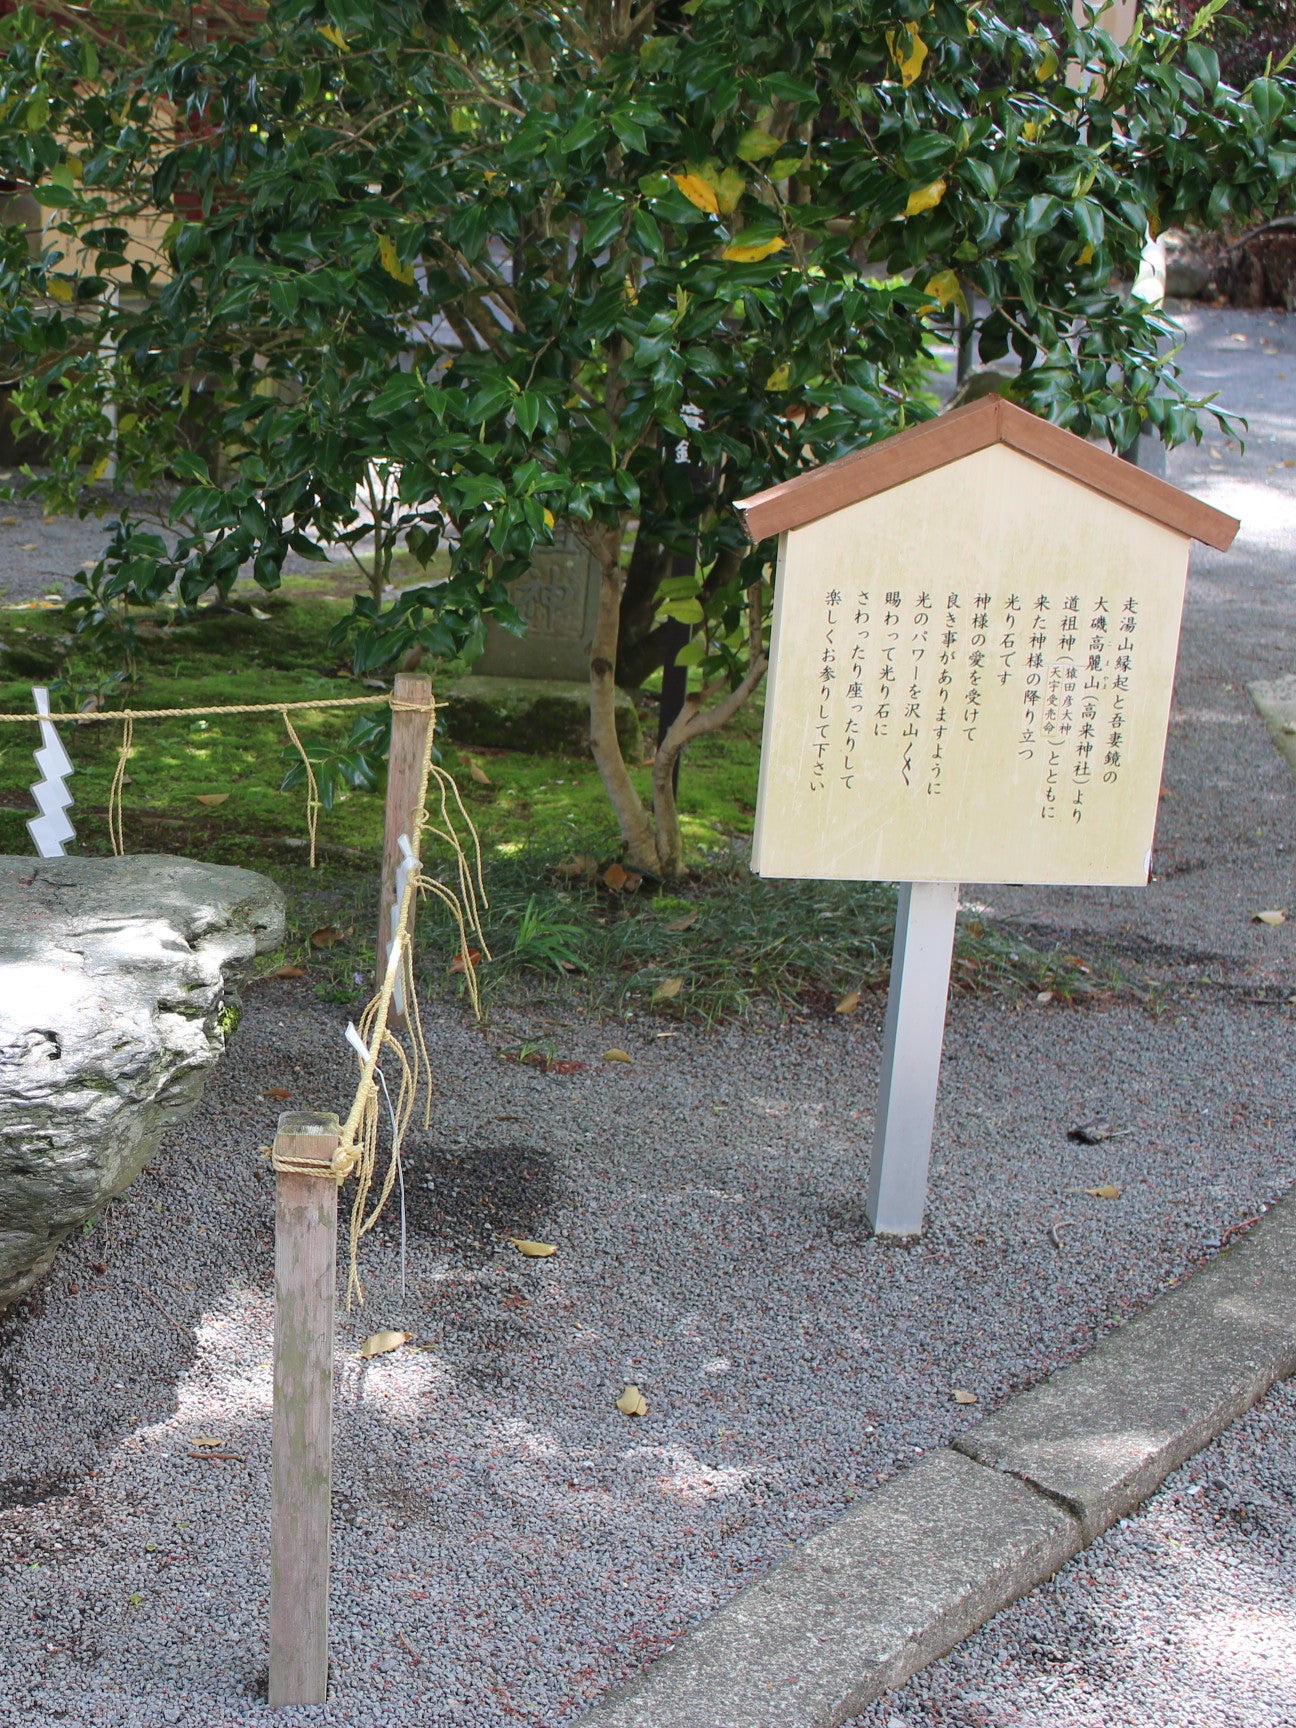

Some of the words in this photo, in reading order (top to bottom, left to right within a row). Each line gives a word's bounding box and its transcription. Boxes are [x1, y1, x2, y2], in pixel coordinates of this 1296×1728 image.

[810, 588, 843, 792] 楽しくお参りして下さい
[840, 590, 870, 790] さわったり座ったりして
[874, 591, 902, 737] 賜わって光り石に
[927, 591, 962, 795] 良き事がありますように
[962, 592, 992, 742] 神様の愛を受けて
[997, 592, 1022, 686] 光り石です
[1018, 594, 1051, 760] 来た神様の降り立つ
[1103, 595, 1140, 784] 走湯山縁起と吾妻鏡の
